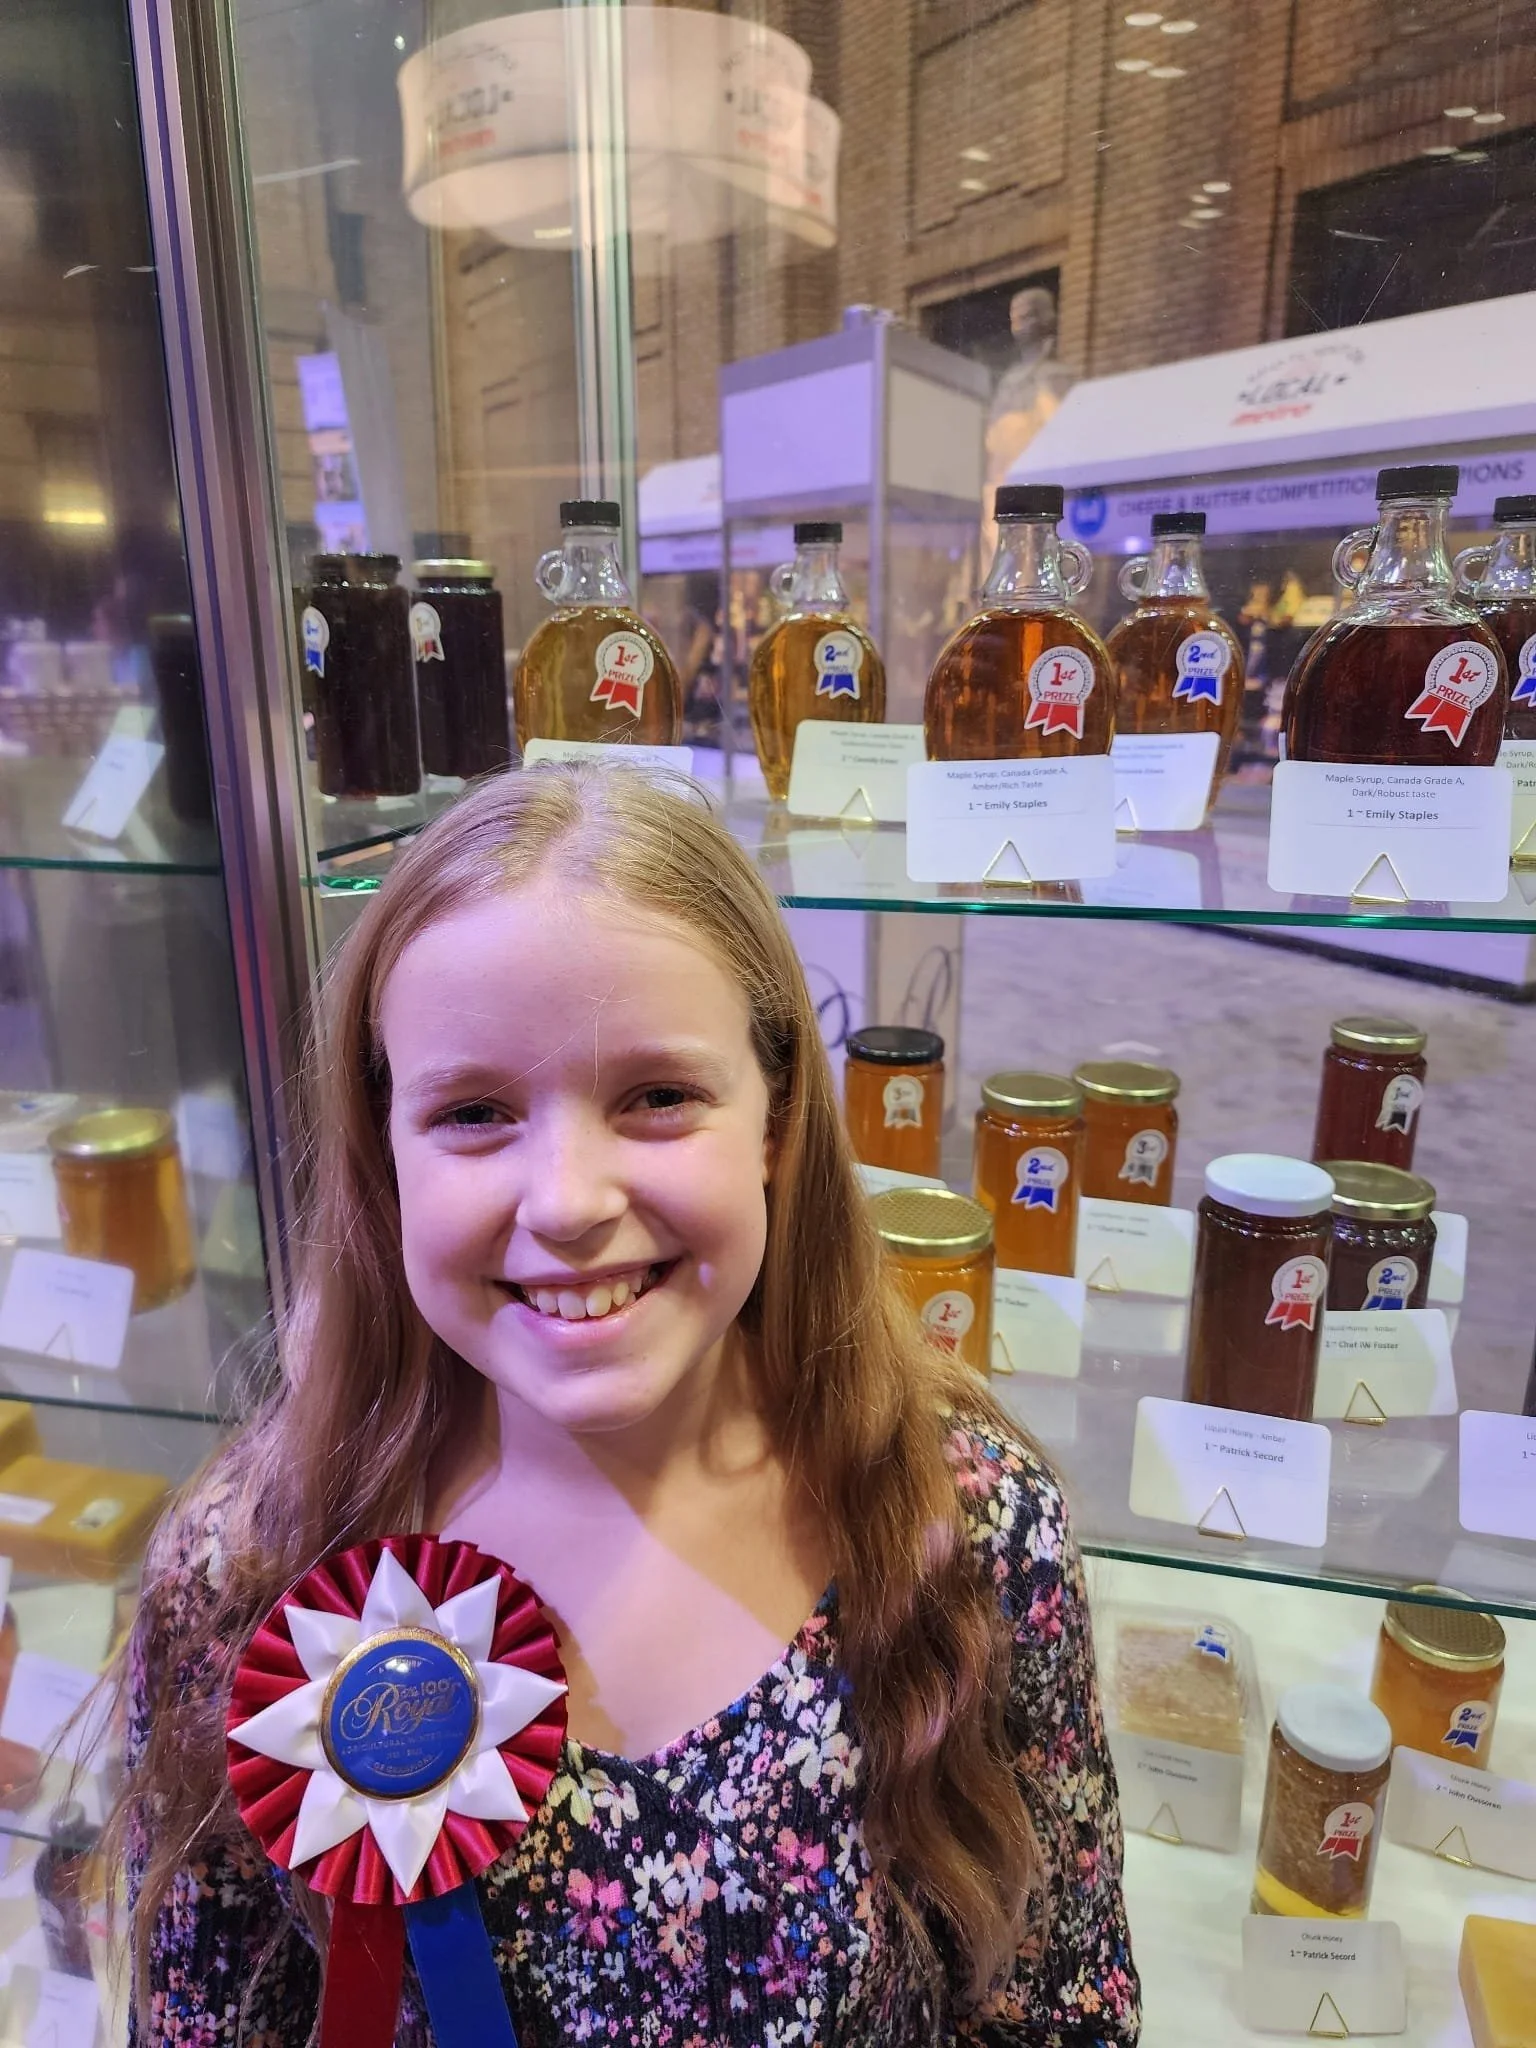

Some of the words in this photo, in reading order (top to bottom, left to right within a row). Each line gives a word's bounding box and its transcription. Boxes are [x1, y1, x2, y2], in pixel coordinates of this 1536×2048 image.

[615, 646, 638, 667] 1st
[825, 645, 850, 661] 2nd
[1188, 645, 1217, 664] 2nd
[608, 669, 636, 683] PRIZE
[1050, 662, 1077, 686] 1st
[1188, 667, 1214, 676] PRIZE
[1449, 657, 1482, 685] 1st
[1044, 690, 1076, 702] PRIZE
[1436, 684, 1471, 706] PRIZE
[947, 771, 972, 780] Maple
[1000, 769, 1031, 778] Canada
[1032, 767, 1057, 776] Grade
[1325, 774, 1354, 784] Maple
[1355, 775, 1384, 785] Syrup,
[1387, 776, 1422, 785] Canada
[1424, 776, 1453, 785] Grade
[1455, 777, 1465, 786] A,
[972, 781, 1019, 791] Amber/Rich
[1022, 780, 1043, 789] Taste
[1352, 788, 1409, 798] Dark/Robust
[1412, 790, 1436, 799] taste
[984, 801, 1010, 811] Emily
[1012, 799, 1048, 810] Staples
[1366, 809, 1395, 821] Emily
[1398, 810, 1439, 822] Staples
[1028, 1157, 1055, 1174] 2nd
[1291, 1269, 1314, 1288] 1st
[1379, 1267, 1408, 1284] 2nd
[1285, 1292, 1310, 1301] PRIZE
[1378, 1287, 1402, 1296] PRIZE
[939, 1302, 962, 1321] 1st
[1339, 1341, 1357, 1349] Chef
[1373, 1342, 1399, 1350] Foster
[1204, 1423, 1227, 1434] Liquid
[1229, 1427, 1253, 1439] Honey
[1261, 1433, 1286, 1443] Amber
[1219, 1444, 1250, 1457] Patrick
[1253, 1450, 1284, 1463] Secord
[341, 1682, 461, 1740] Royal
[1459, 1707, 1486, 1721] 2nd
[1340, 1811, 1362, 1827] 1st
[1303, 1950, 1329, 1960] Patrick
[1330, 1951, 1356, 1961] Secord
